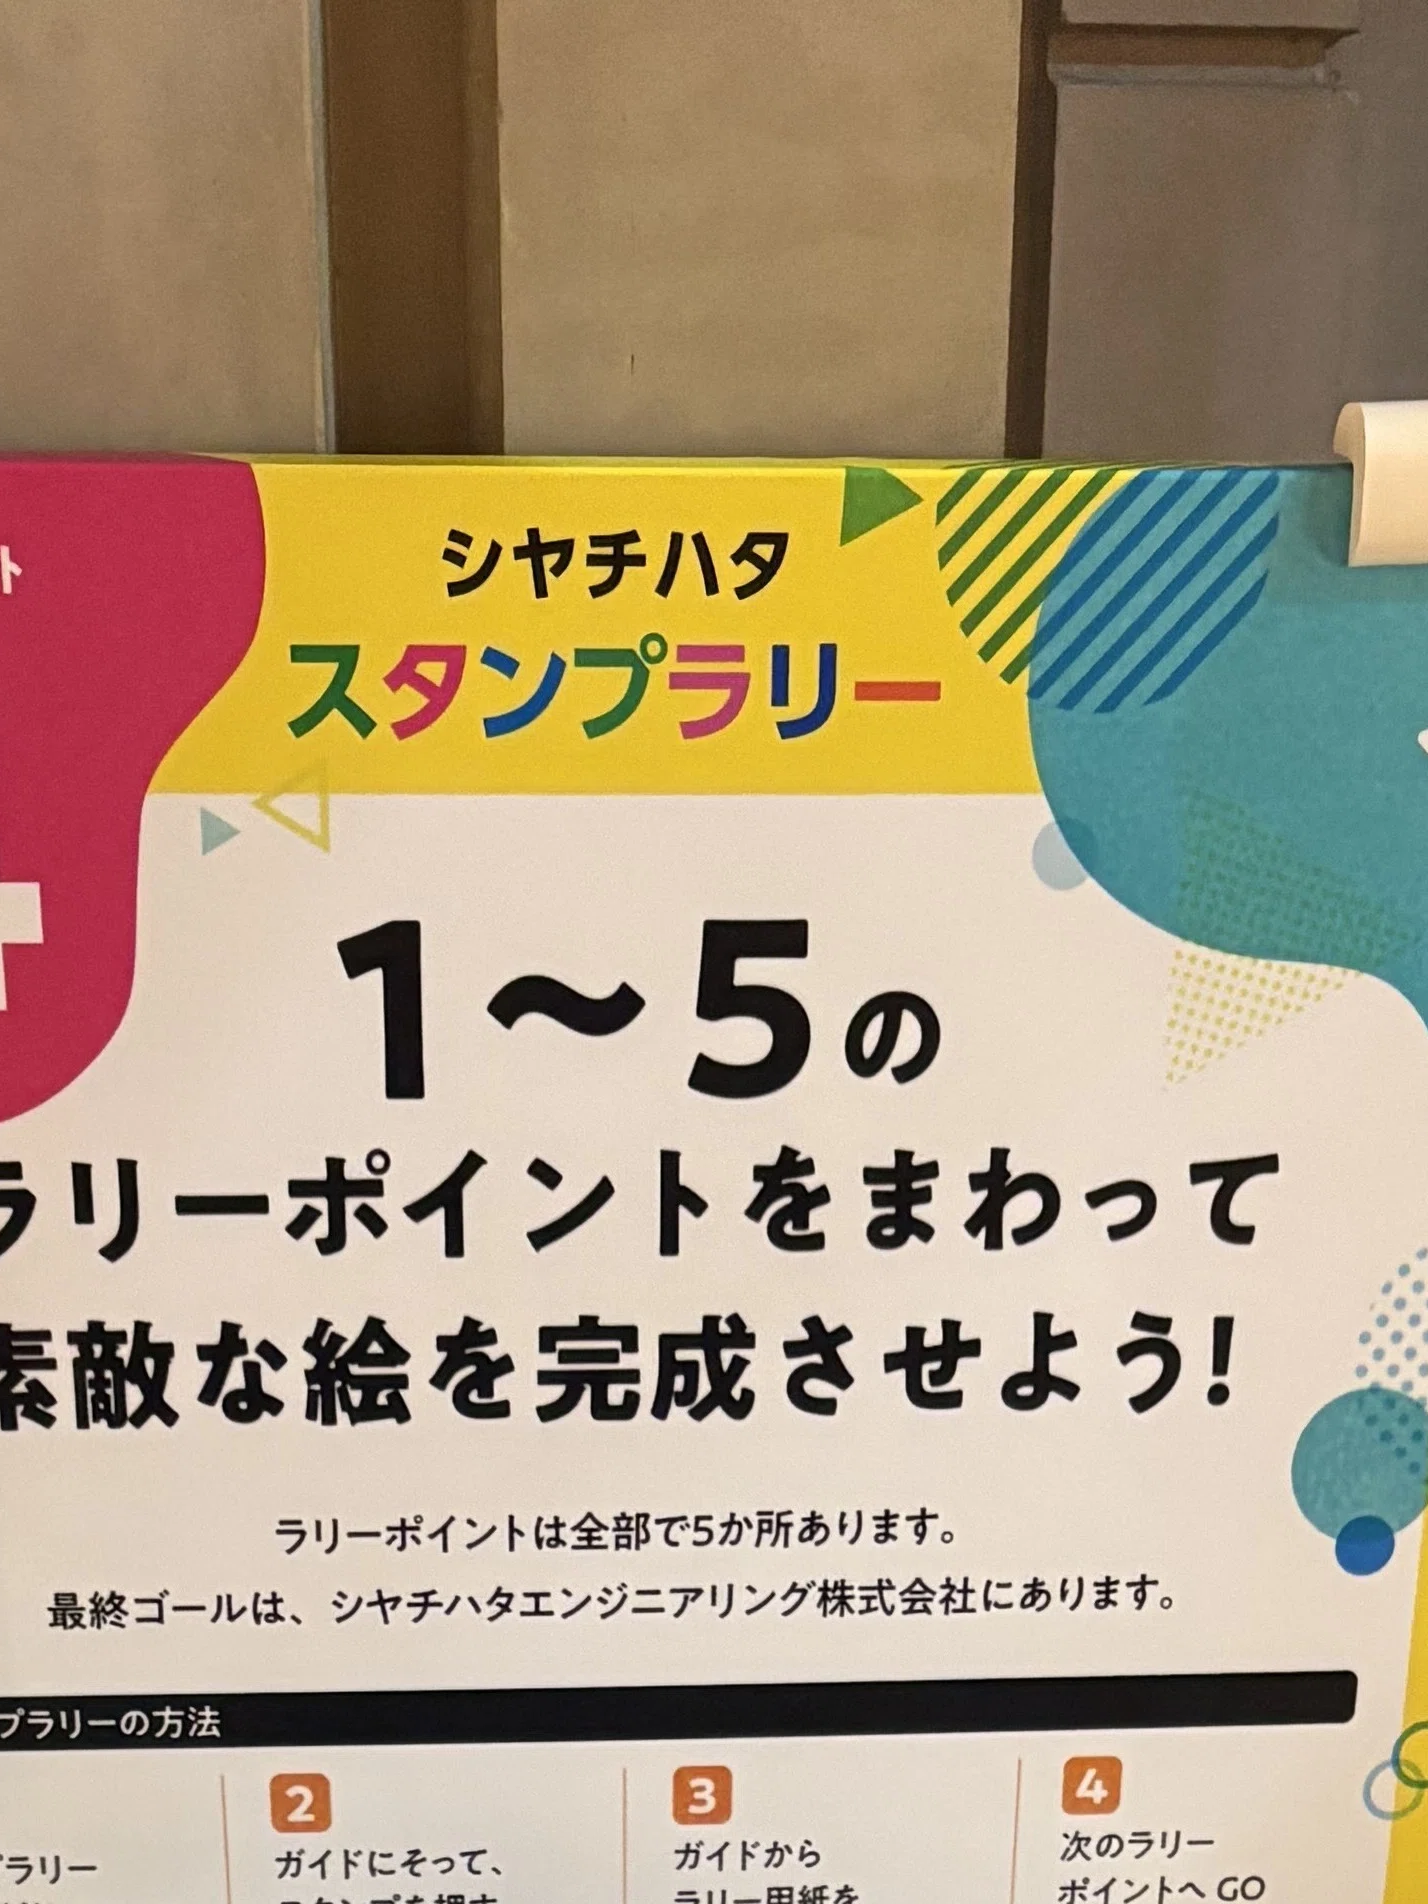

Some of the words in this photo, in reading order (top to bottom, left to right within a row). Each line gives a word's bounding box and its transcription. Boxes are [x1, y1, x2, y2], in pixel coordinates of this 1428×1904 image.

[441, 527, 790, 601] シヤチハタ
[287, 632, 942, 741] スタンプラリー
[274, 1506, 956, 1556] ラリーポイントは全部で5か所あります。
[45, 1572, 1175, 1632] 最終ゴールは、シヤチハタエンジニアリング株式会社にあります。
[284, 1784, 316, 1823] 2
[686, 1776, 717, 1815] 3
[1074, 1766, 1110, 1805] 4
[274, 1847, 504, 1881] ガイドにそって、
[673, 1838, 822, 1873] ガイドから
[1059, 1829, 1216, 1863] 次のラリー
[1215, 1874, 1267, 1903] GO
